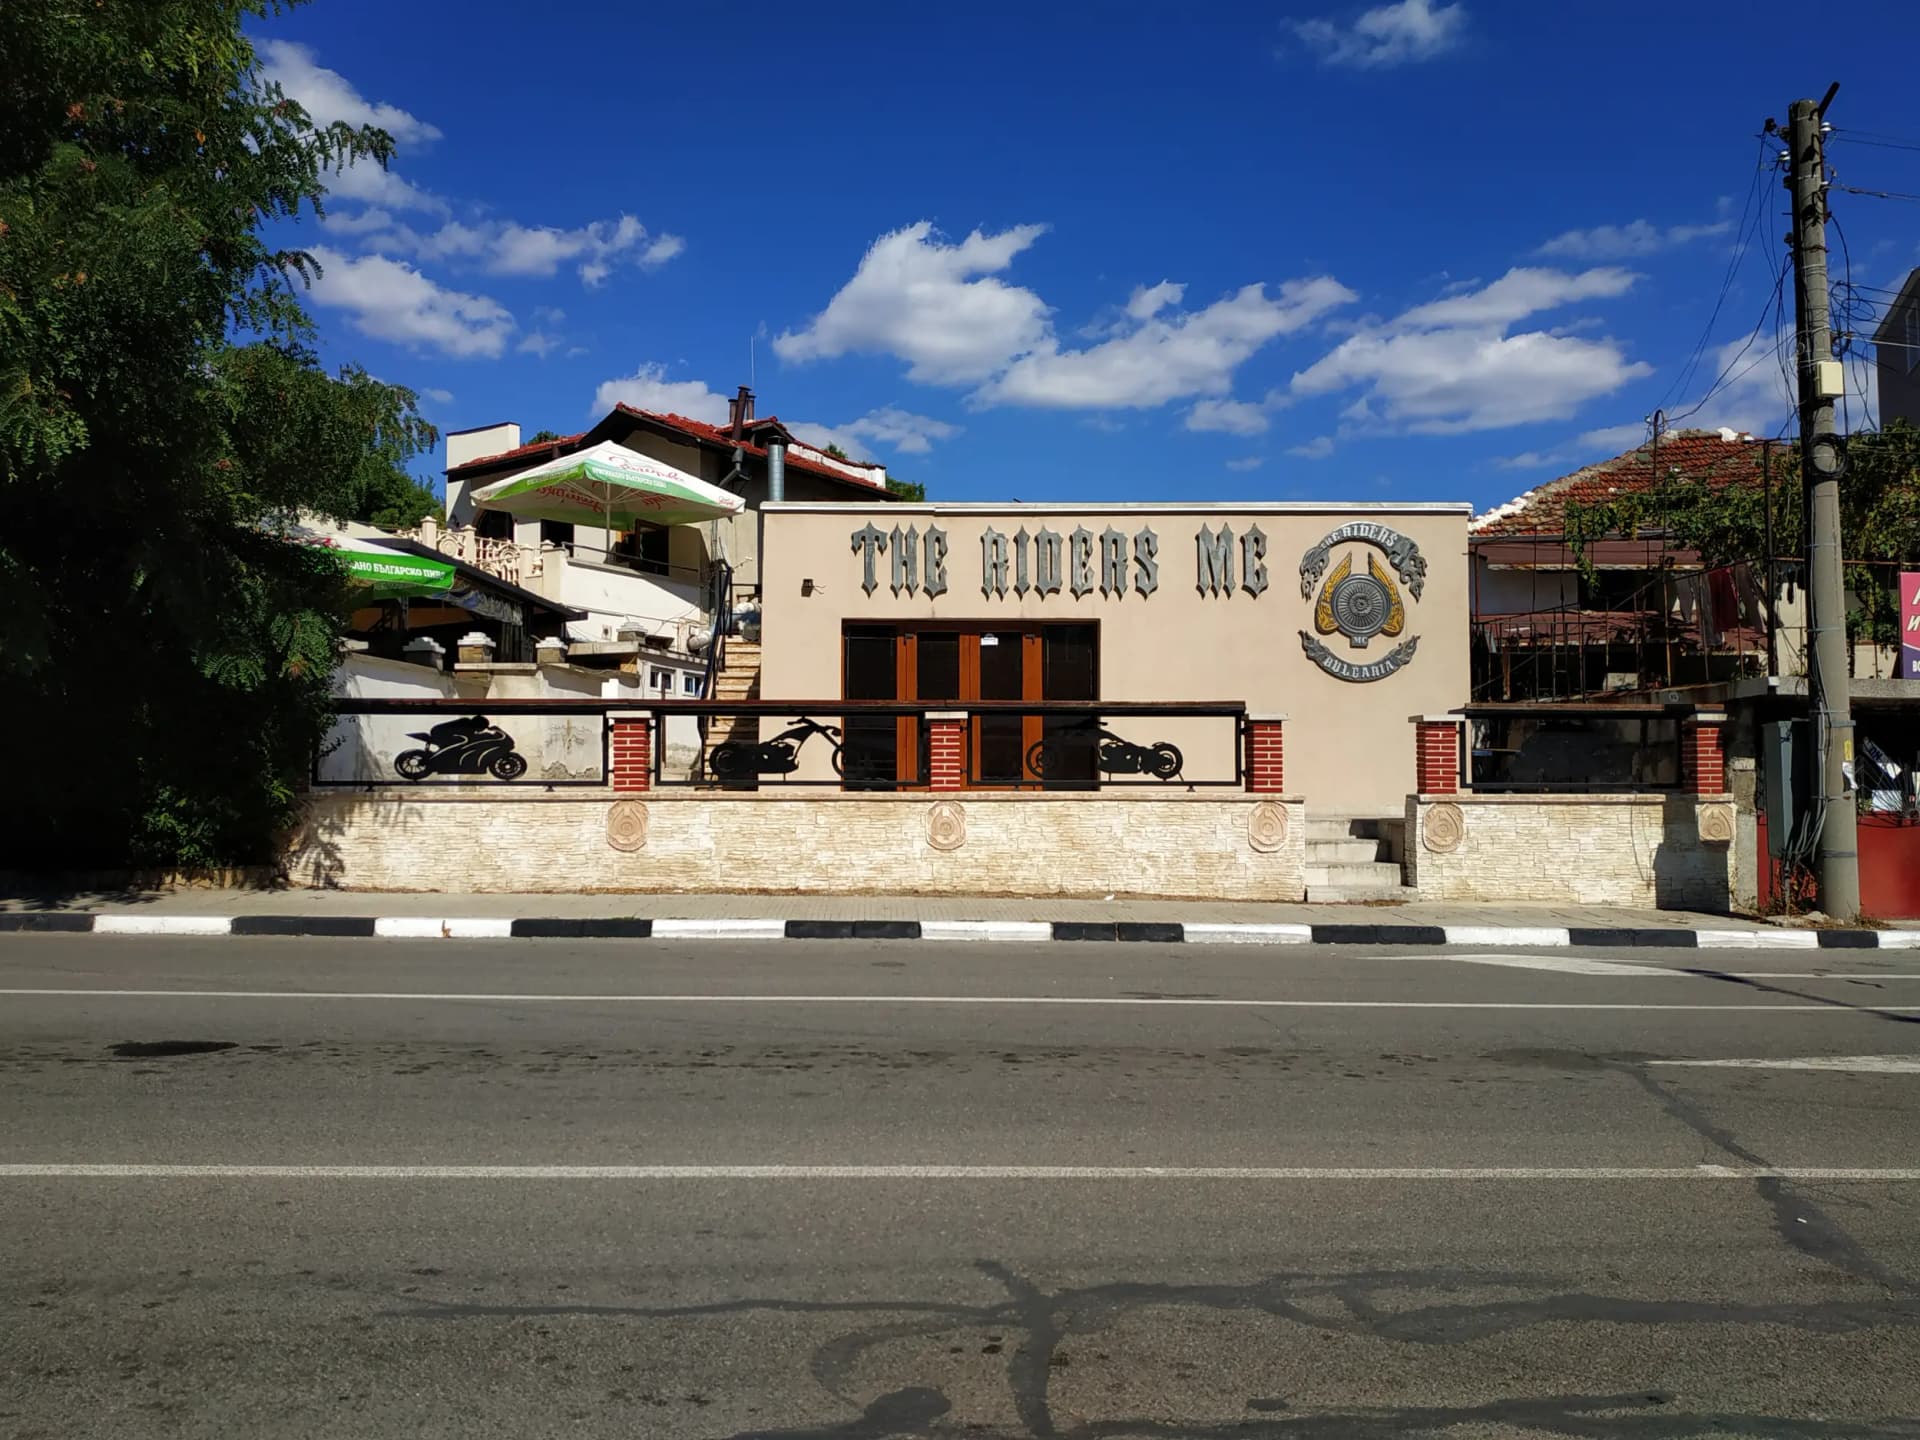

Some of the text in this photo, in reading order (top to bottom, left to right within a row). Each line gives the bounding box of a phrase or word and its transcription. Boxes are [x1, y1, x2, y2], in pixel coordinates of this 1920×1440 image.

[1342, 524, 1398, 547] RIDERS
[373, 563, 423, 577] БЪЛГАРСКО
[850, 520, 948, 600] THE
[980, 523, 1159, 602] RIDERS
[1353, 636, 1368, 644] MC
[1323, 656, 1395, 678] BULGARIA
